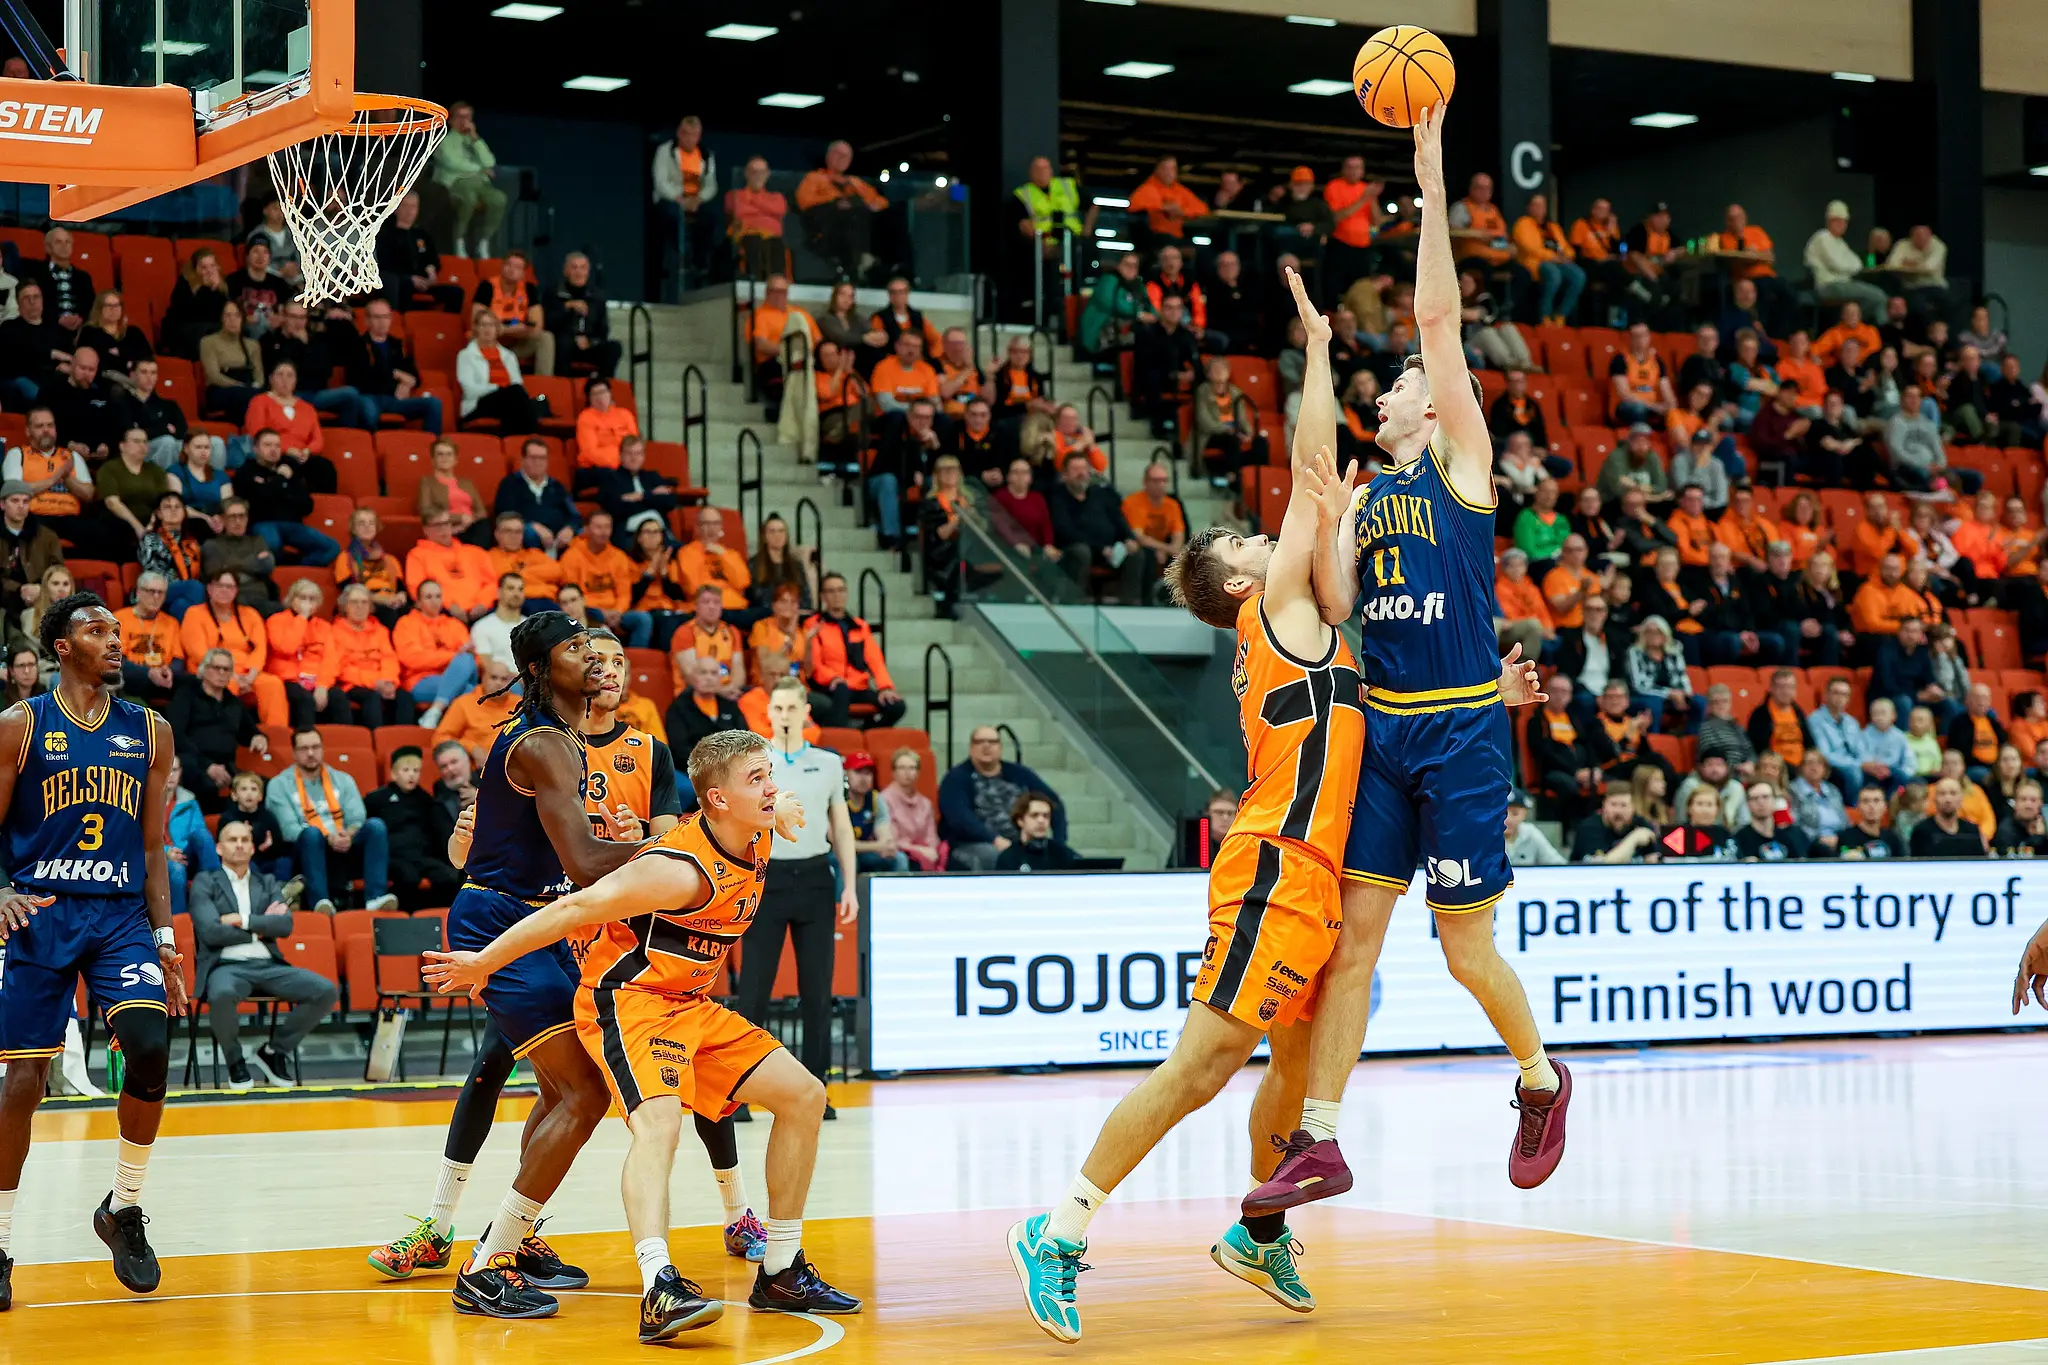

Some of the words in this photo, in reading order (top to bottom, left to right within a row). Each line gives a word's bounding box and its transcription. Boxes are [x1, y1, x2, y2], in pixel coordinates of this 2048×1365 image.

[0, 101, 103, 134] STEM
[1511, 141, 1543, 189] C
[1373, 546, 1405, 588] 11
[41, 766, 142, 822] HELSINKI
[77, 813, 104, 851] 3
[685, 918, 722, 930] serres
[730, 890, 758, 922] 12
[1518, 888, 1631, 951] part
[1650, 881, 1703, 933] of
[1719, 881, 1803, 931] the
[1823, 885, 1953, 941] story
[1972, 876, 2022, 926] of
[120, 962, 166, 991] SO
[1554, 967, 1751, 1023] Finnish
[1771, 963, 1912, 1015] wood
[1100, 1030, 1168, 1051] SINCE
